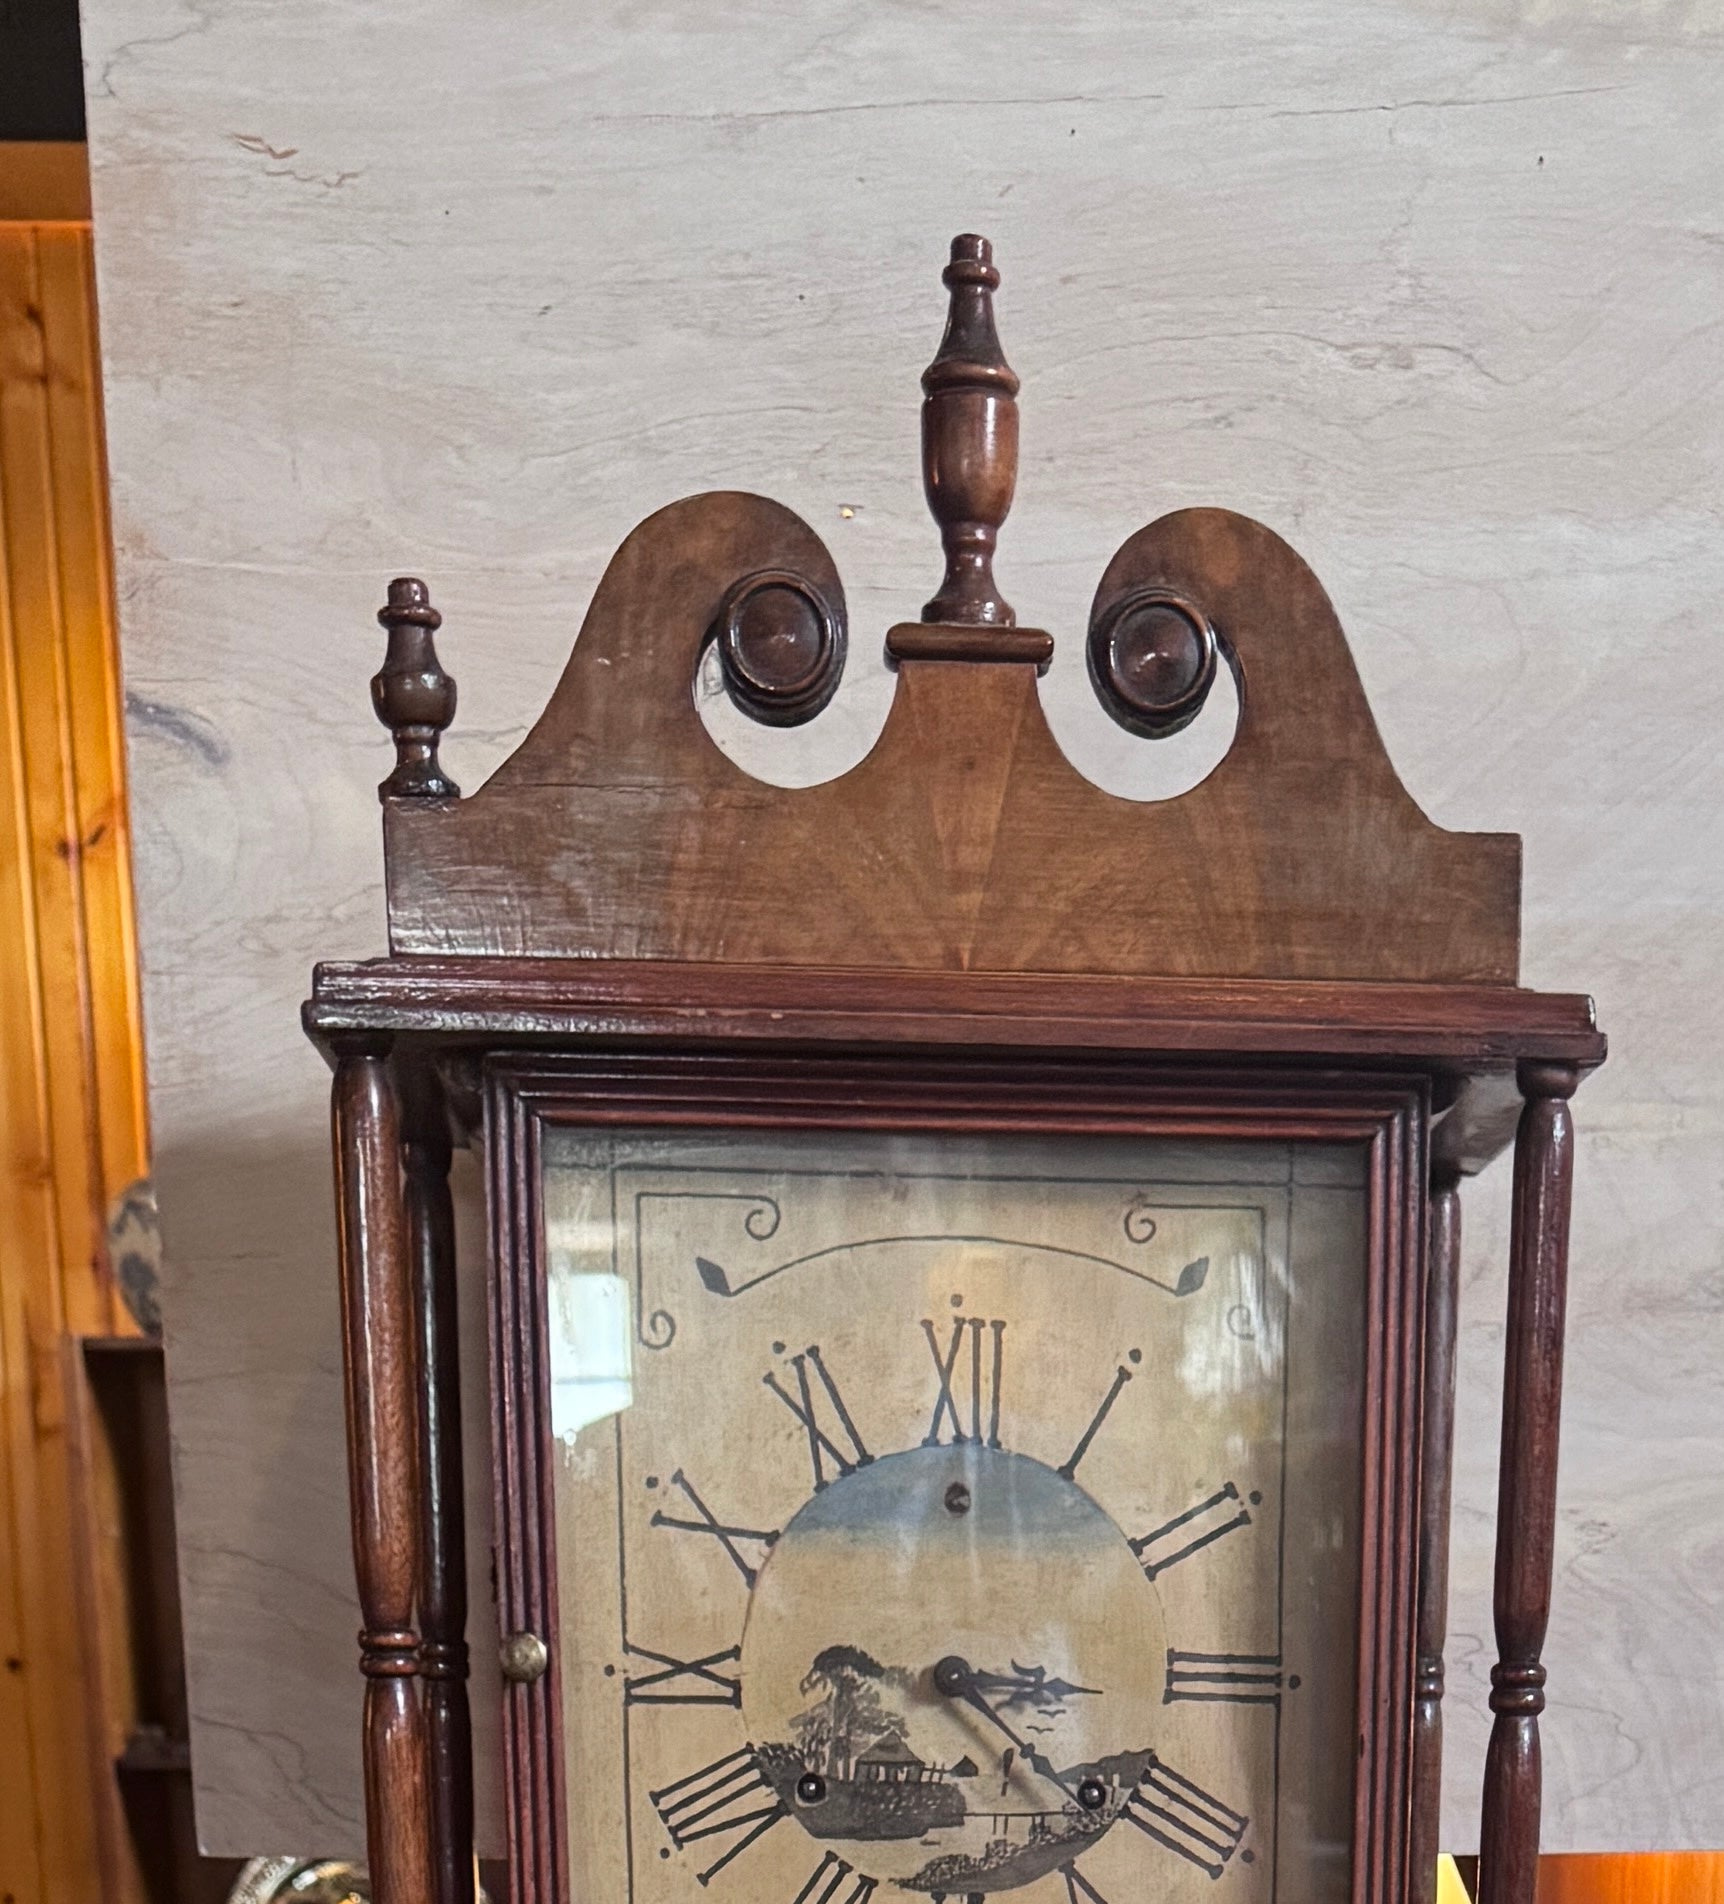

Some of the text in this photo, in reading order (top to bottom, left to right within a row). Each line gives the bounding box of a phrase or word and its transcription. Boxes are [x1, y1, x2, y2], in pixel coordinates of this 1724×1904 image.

[762, 1344, 876, 1494] XI
[920, 1317, 1007, 1449] XII
[1057, 1366, 1132, 1480] I
[650, 1467, 782, 1591] X
[1127, 1482, 1252, 1581] II
[623, 1643, 743, 1710] IX
[1163, 1649, 1284, 1706] III
[648, 1741, 792, 1888] VIII
[1117, 1753, 1251, 1881] IIII
